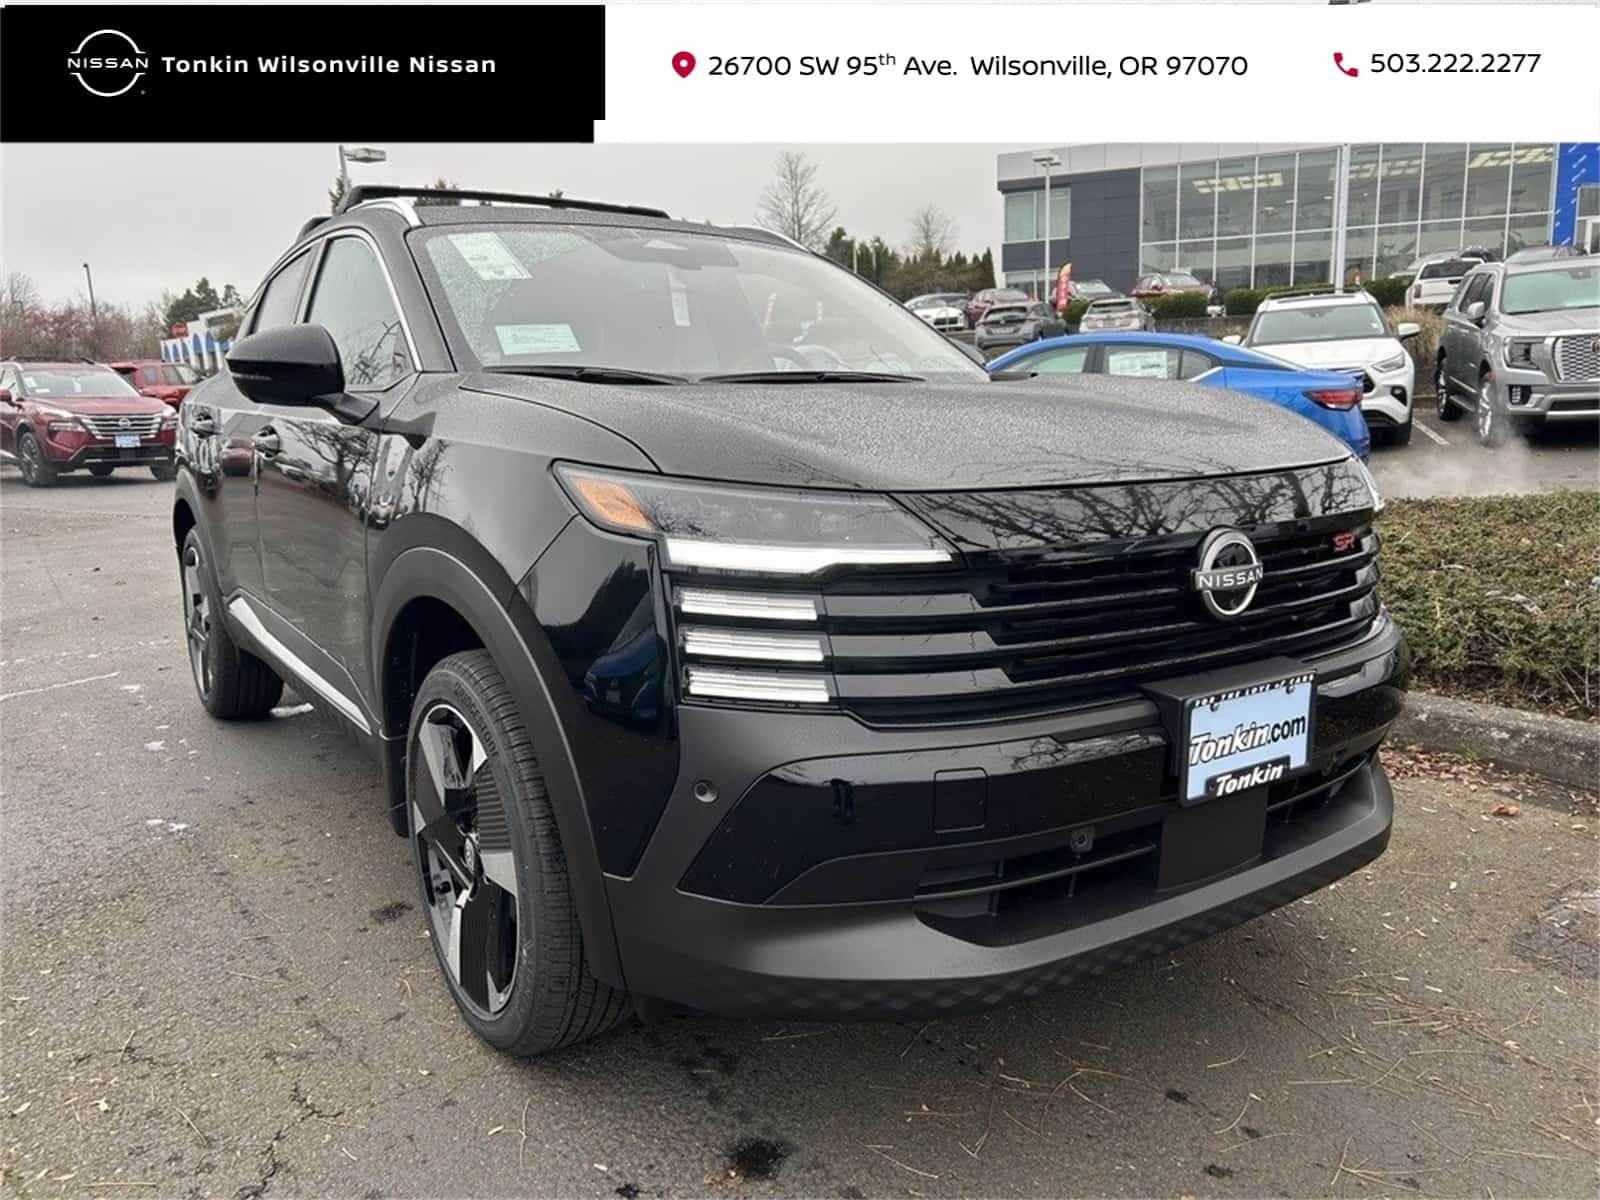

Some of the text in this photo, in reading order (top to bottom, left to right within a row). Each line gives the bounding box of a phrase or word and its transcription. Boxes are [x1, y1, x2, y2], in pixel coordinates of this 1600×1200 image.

[1332, 533, 1354, 551] SR
[1199, 568, 1263, 588] NISSAN
[1189, 716, 1305, 767] Tonkin.com
[1216, 763, 1284, 797] Tonkin
